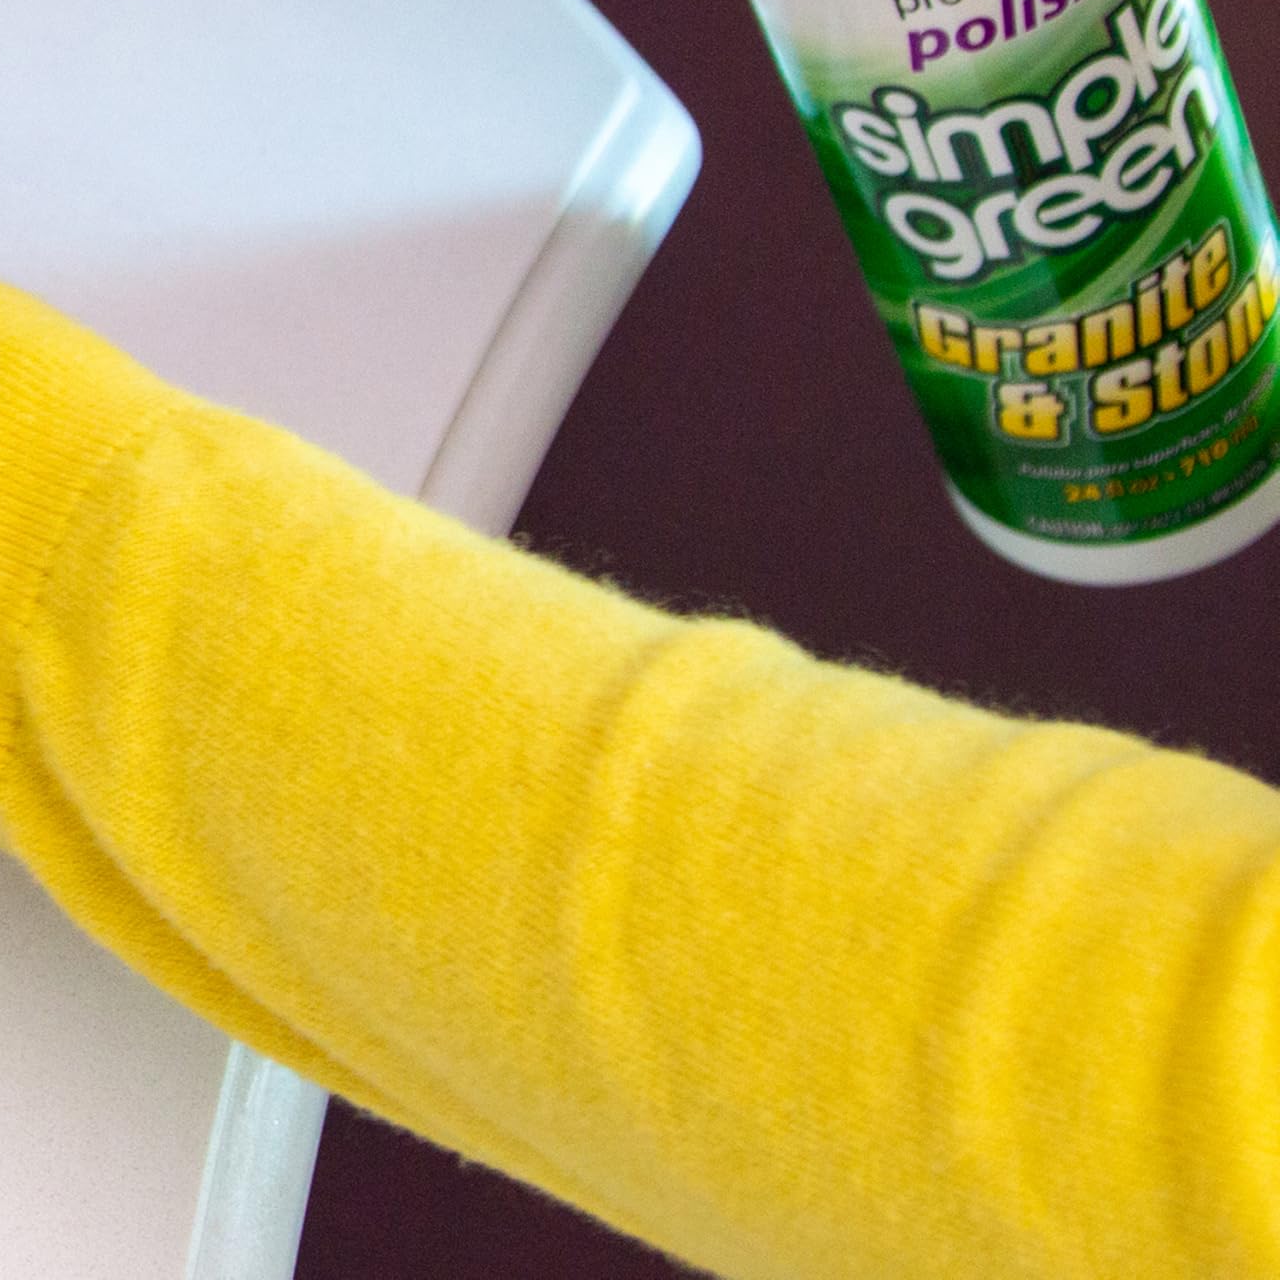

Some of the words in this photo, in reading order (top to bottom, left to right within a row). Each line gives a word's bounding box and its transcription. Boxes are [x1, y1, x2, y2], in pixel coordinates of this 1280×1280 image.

[882, 65, 1219, 281] green
[917, 223, 1232, 376] Granite
[997, 381, 1065, 440] &
